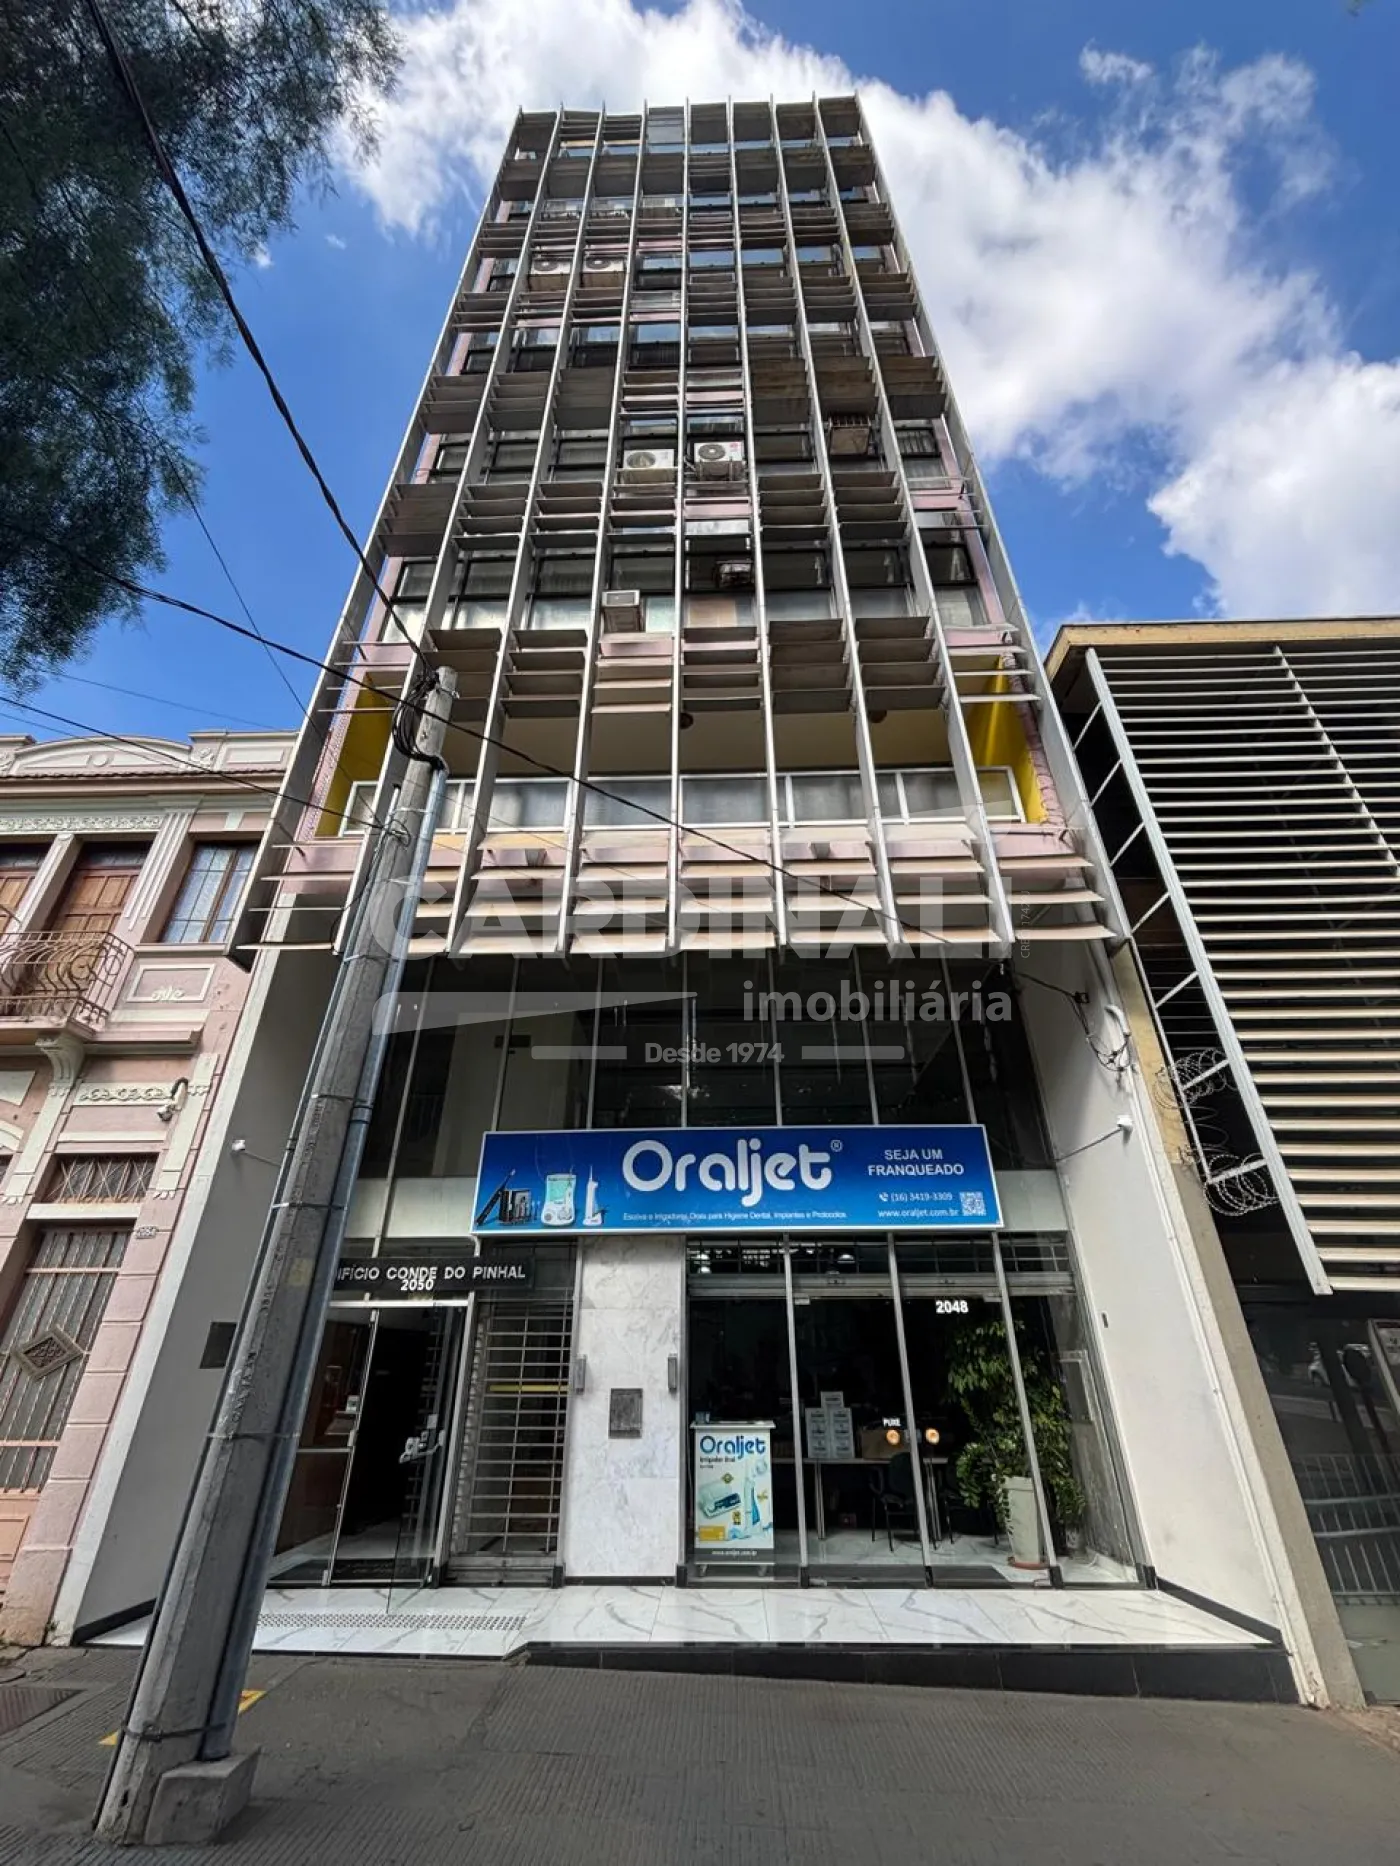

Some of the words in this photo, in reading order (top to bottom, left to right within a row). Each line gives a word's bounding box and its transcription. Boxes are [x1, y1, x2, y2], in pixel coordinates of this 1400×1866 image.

[884, 1149, 919, 1160] SEJA
[921, 1149, 943, 1160] UM
[622, 1138, 832, 1207] Oraljet
[868, 1163, 965, 1176] FRANQUEADO
[878, 1208, 959, 1218] www.oraljet.com.br
[386, 1266, 438, 1280] CONDE
[444, 1266, 466, 1280] DO
[473, 1265, 526, 1279] PINHAL
[400, 1279, 434, 1291] 2050
[935, 1300, 969, 1314] 2048
[700, 1435, 766, 1459] Oraljet
